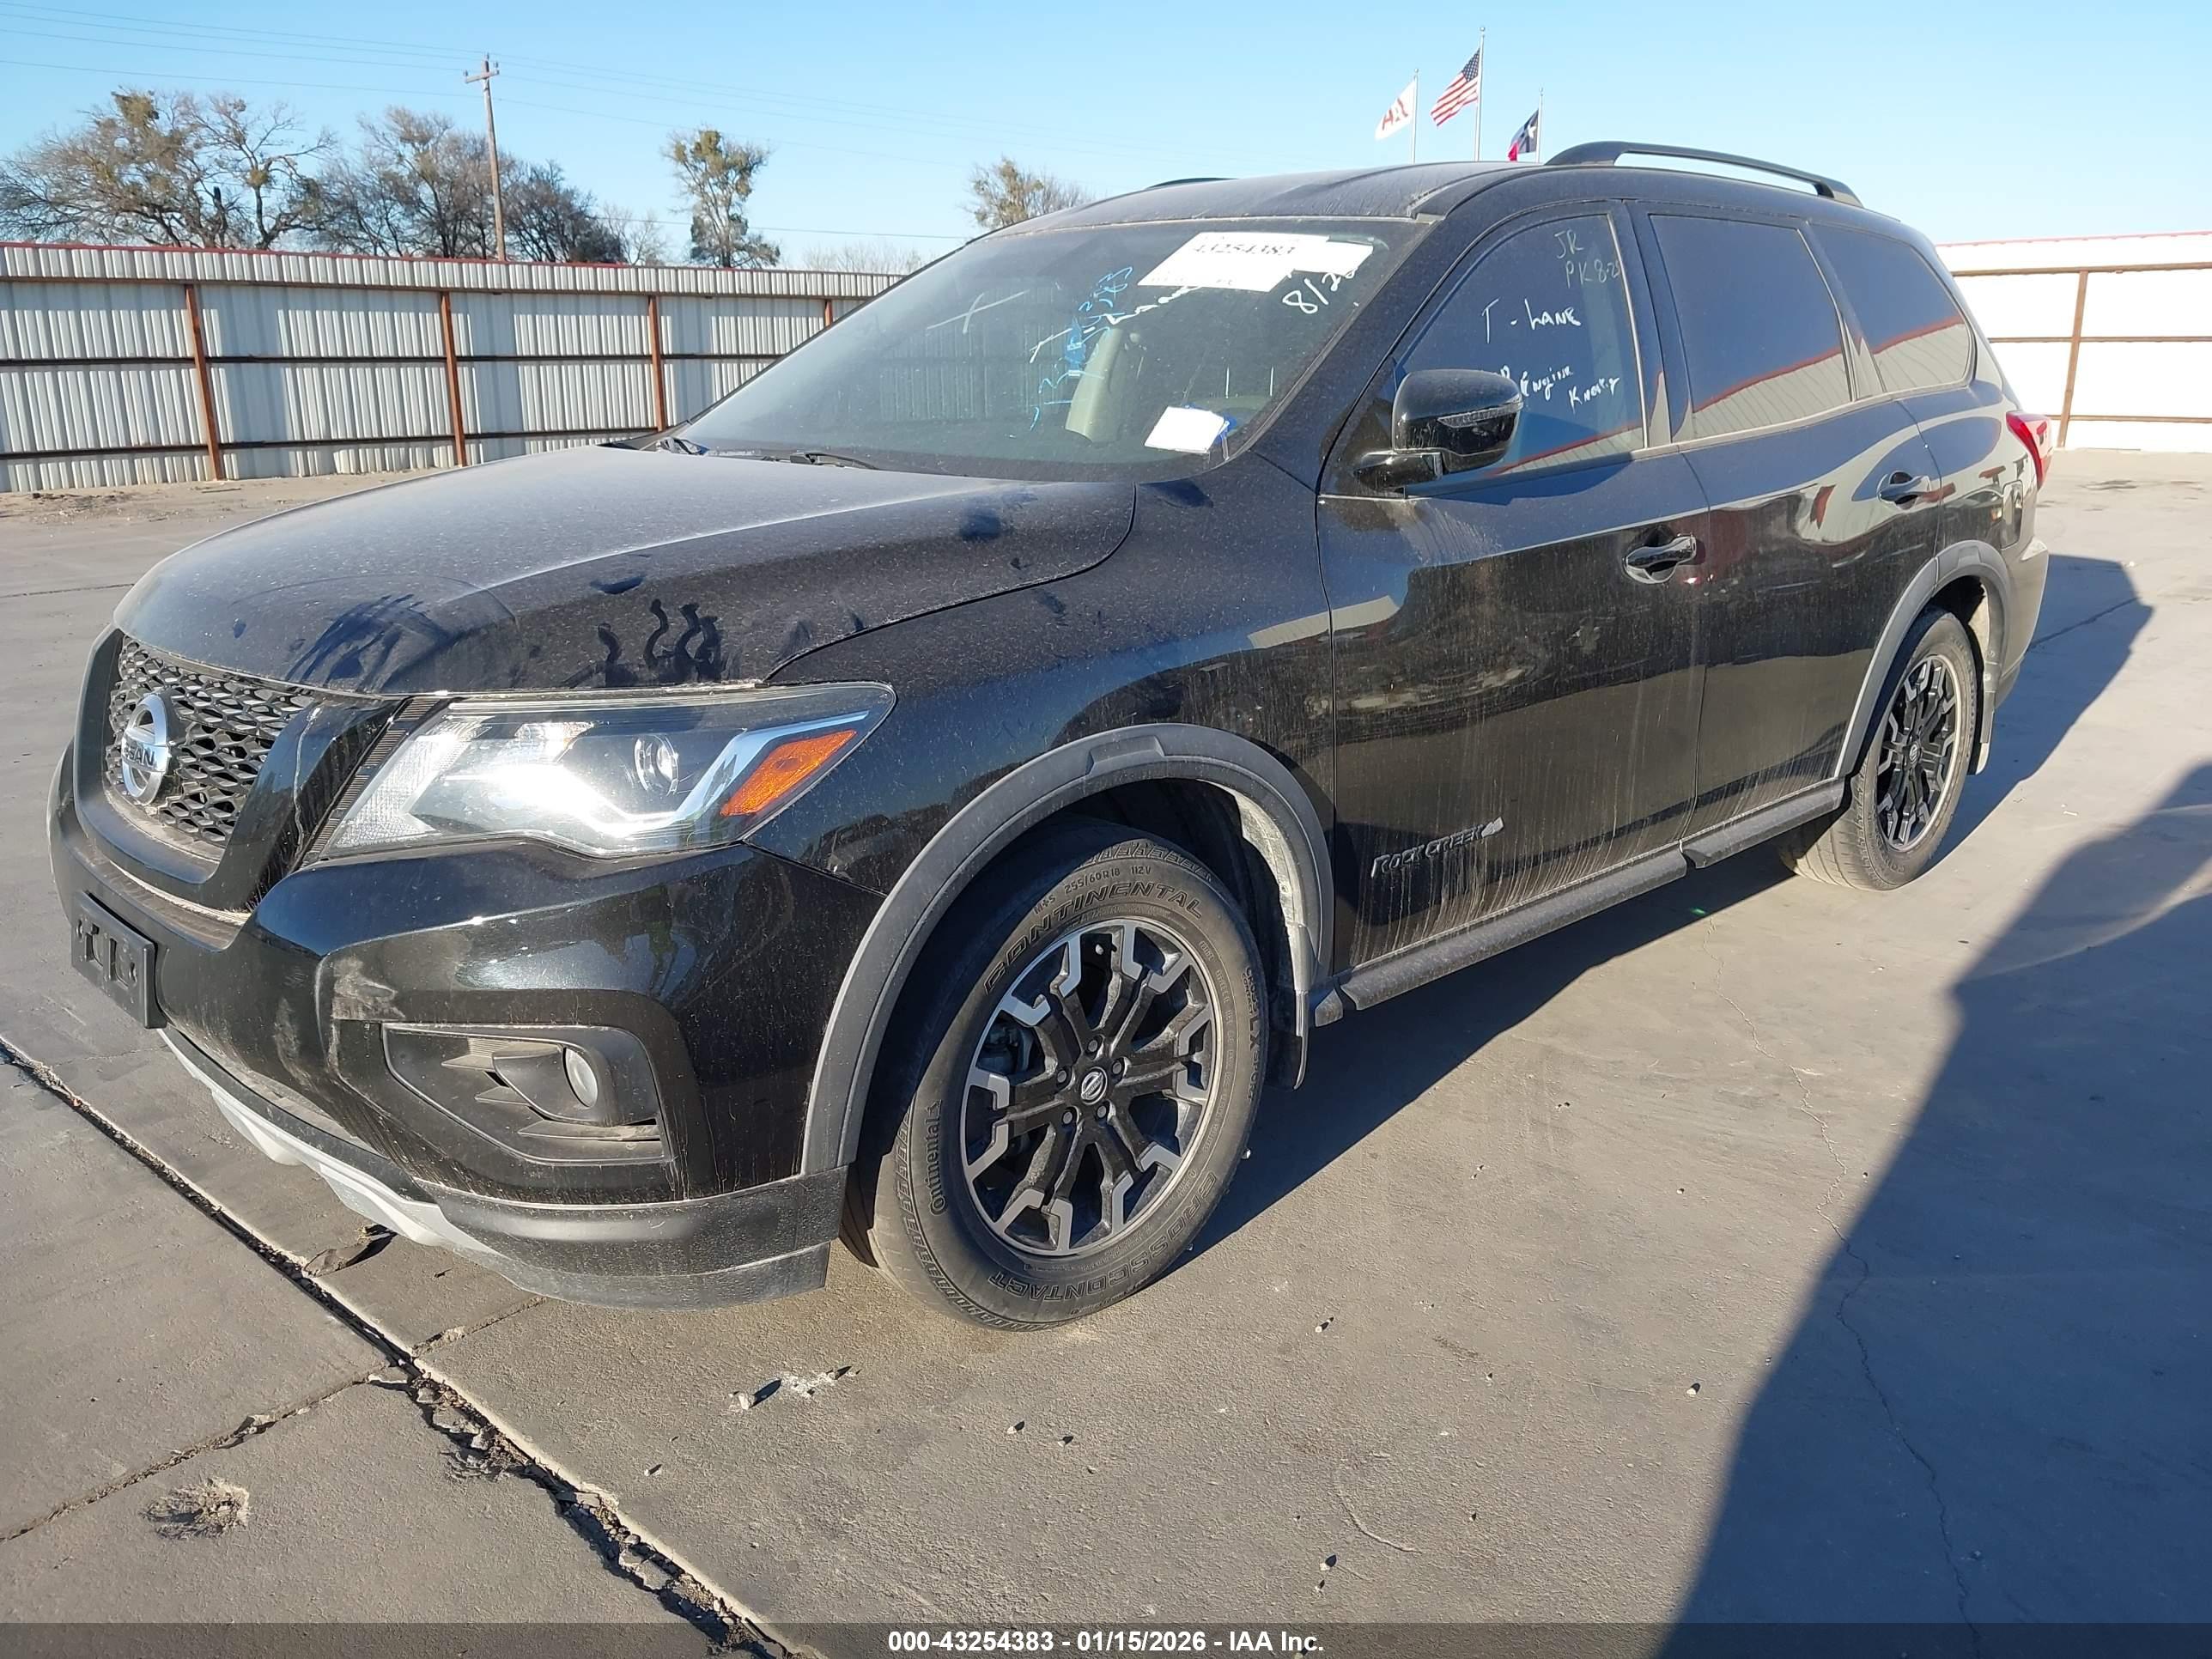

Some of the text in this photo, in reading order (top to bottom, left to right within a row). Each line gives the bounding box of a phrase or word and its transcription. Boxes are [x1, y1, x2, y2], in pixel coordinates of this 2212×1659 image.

[1370, 823, 1485, 879] ROCK CREEK
[983, 881, 1202, 997] CONTINENTAL
[925, 1115, 946, 1216] Continental
